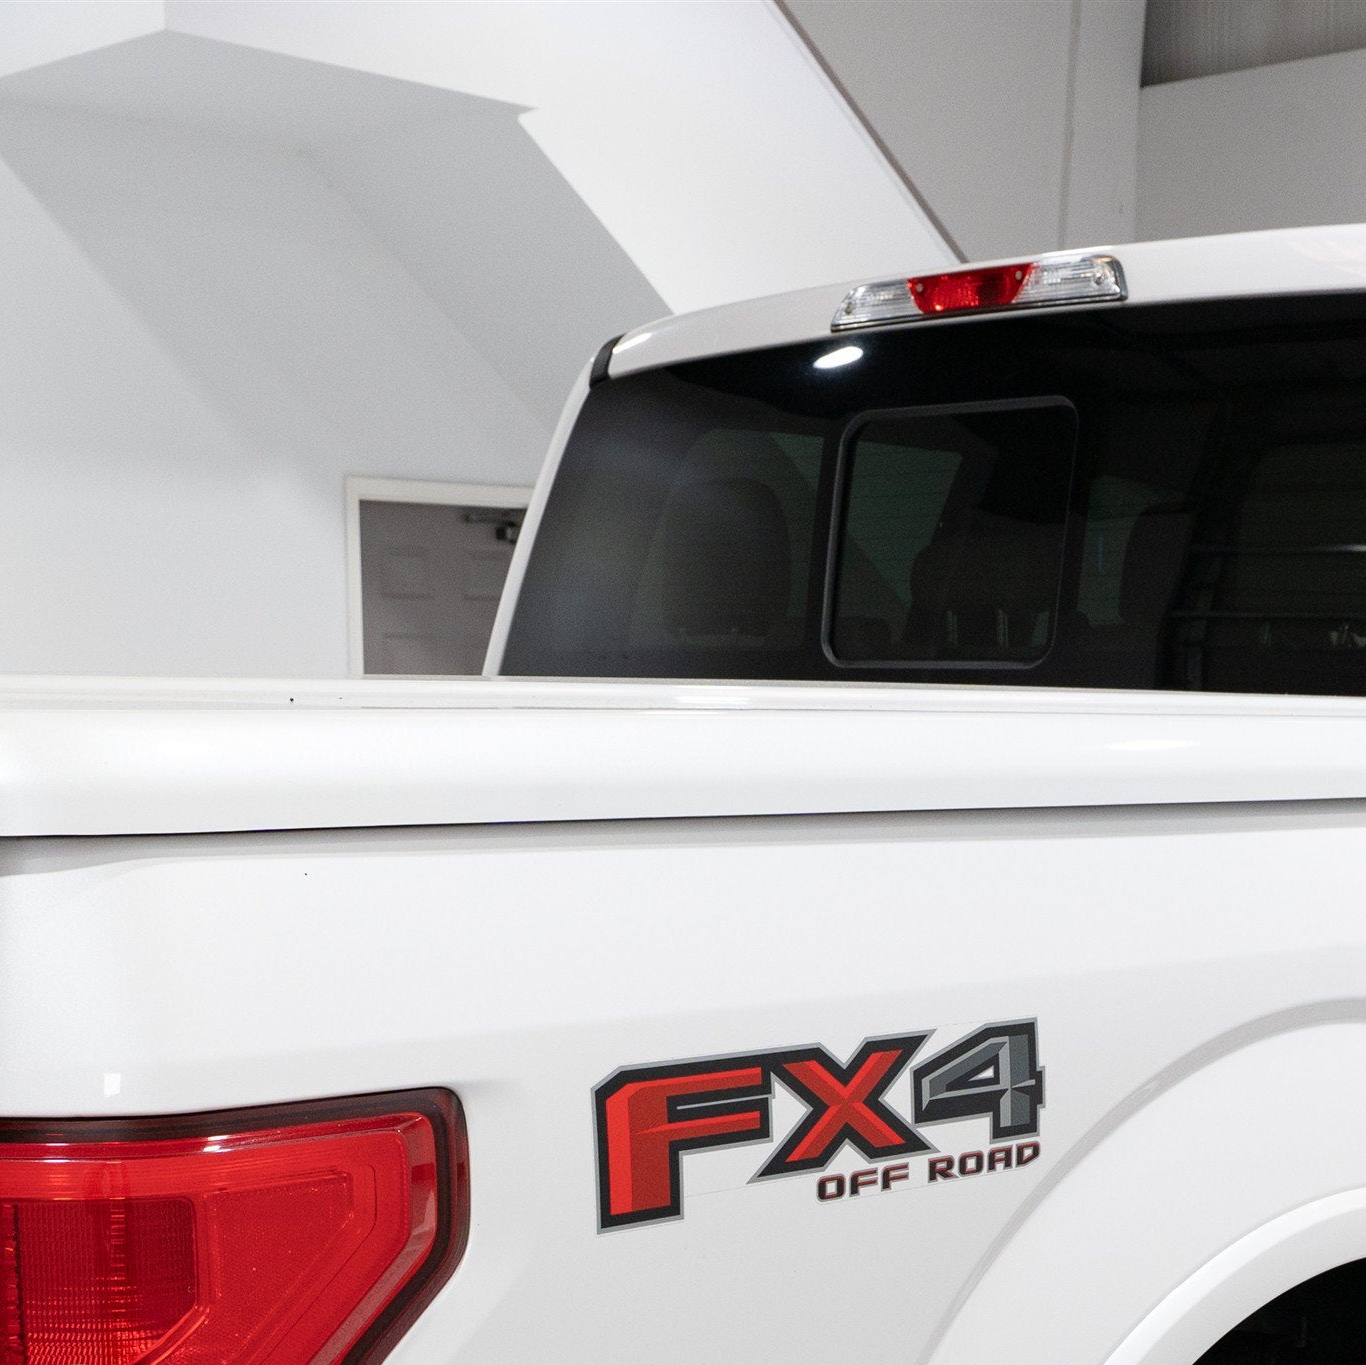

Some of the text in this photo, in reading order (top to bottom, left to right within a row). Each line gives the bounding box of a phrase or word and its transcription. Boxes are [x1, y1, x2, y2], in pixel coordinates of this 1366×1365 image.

[591, 1017, 1045, 1235] FX4
[816, 1141, 1042, 1203] OFF ROAD
